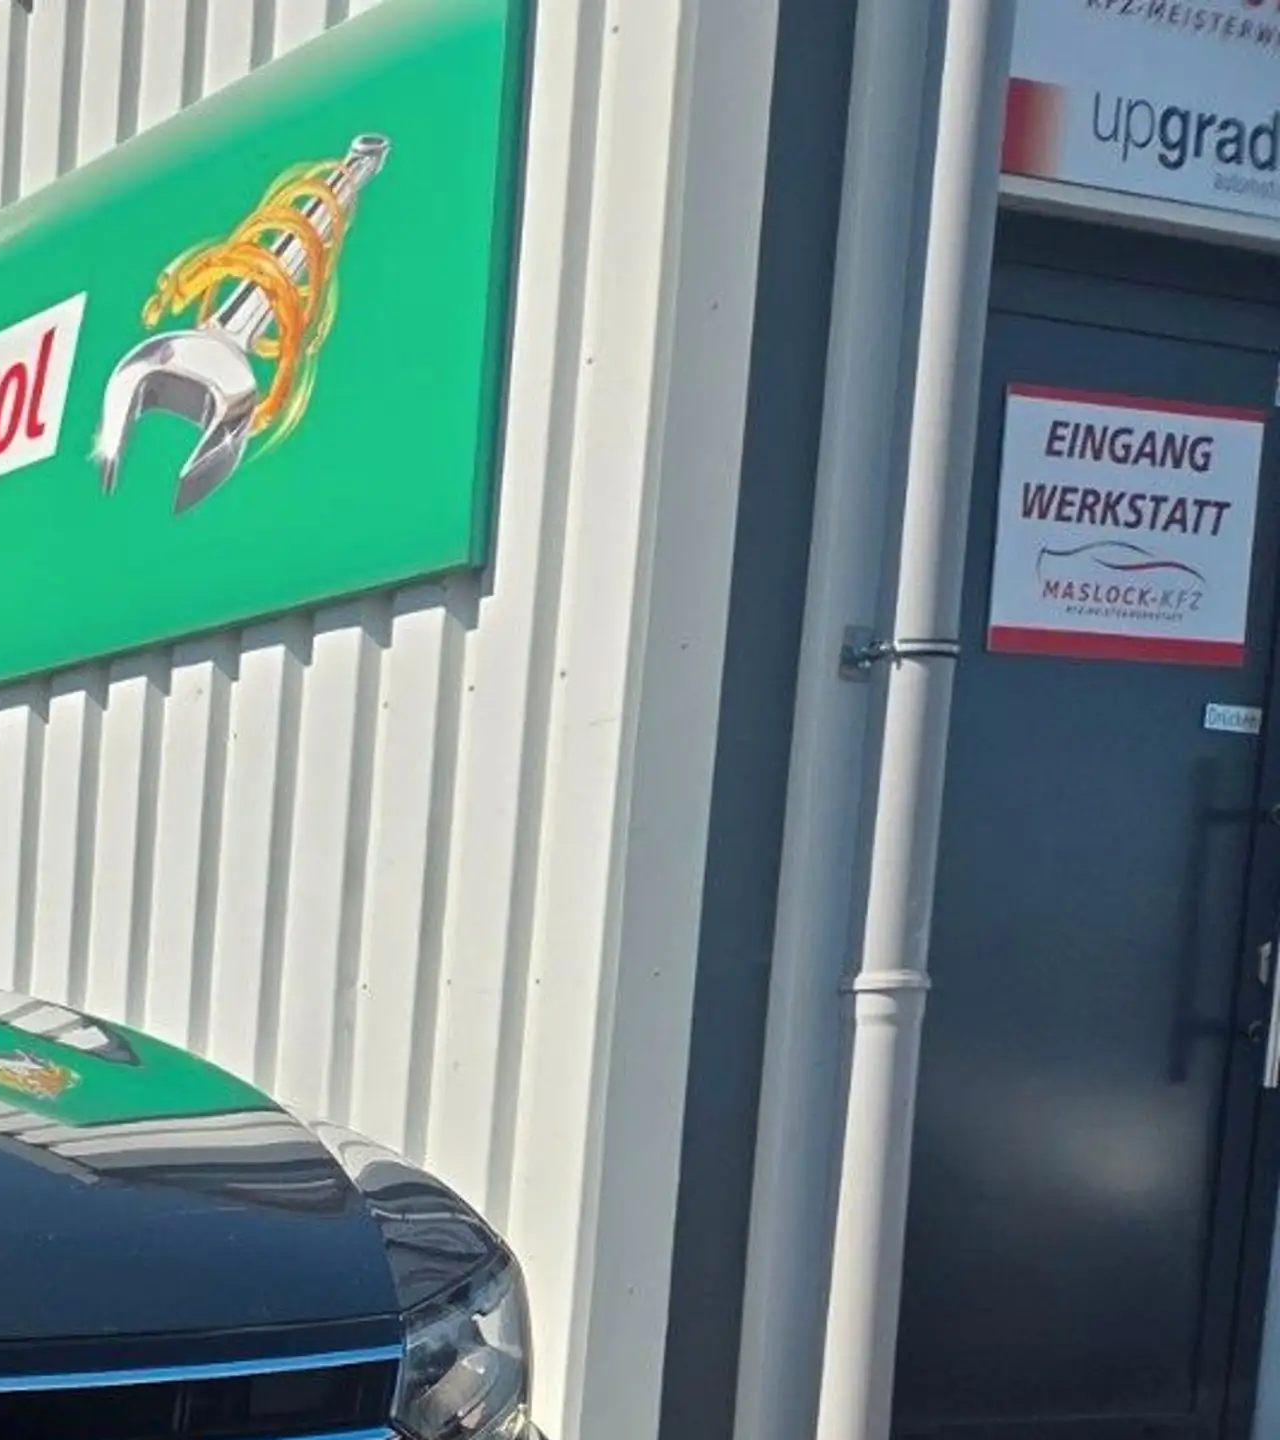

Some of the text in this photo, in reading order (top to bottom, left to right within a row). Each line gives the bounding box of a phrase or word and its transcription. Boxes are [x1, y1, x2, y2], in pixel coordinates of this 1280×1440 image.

[1044, 419, 1215, 473] EINGANG
[1020, 482, 1232, 537] WERKSTATT
[1042, 579, 1204, 611] MASLOCK-KFZ
